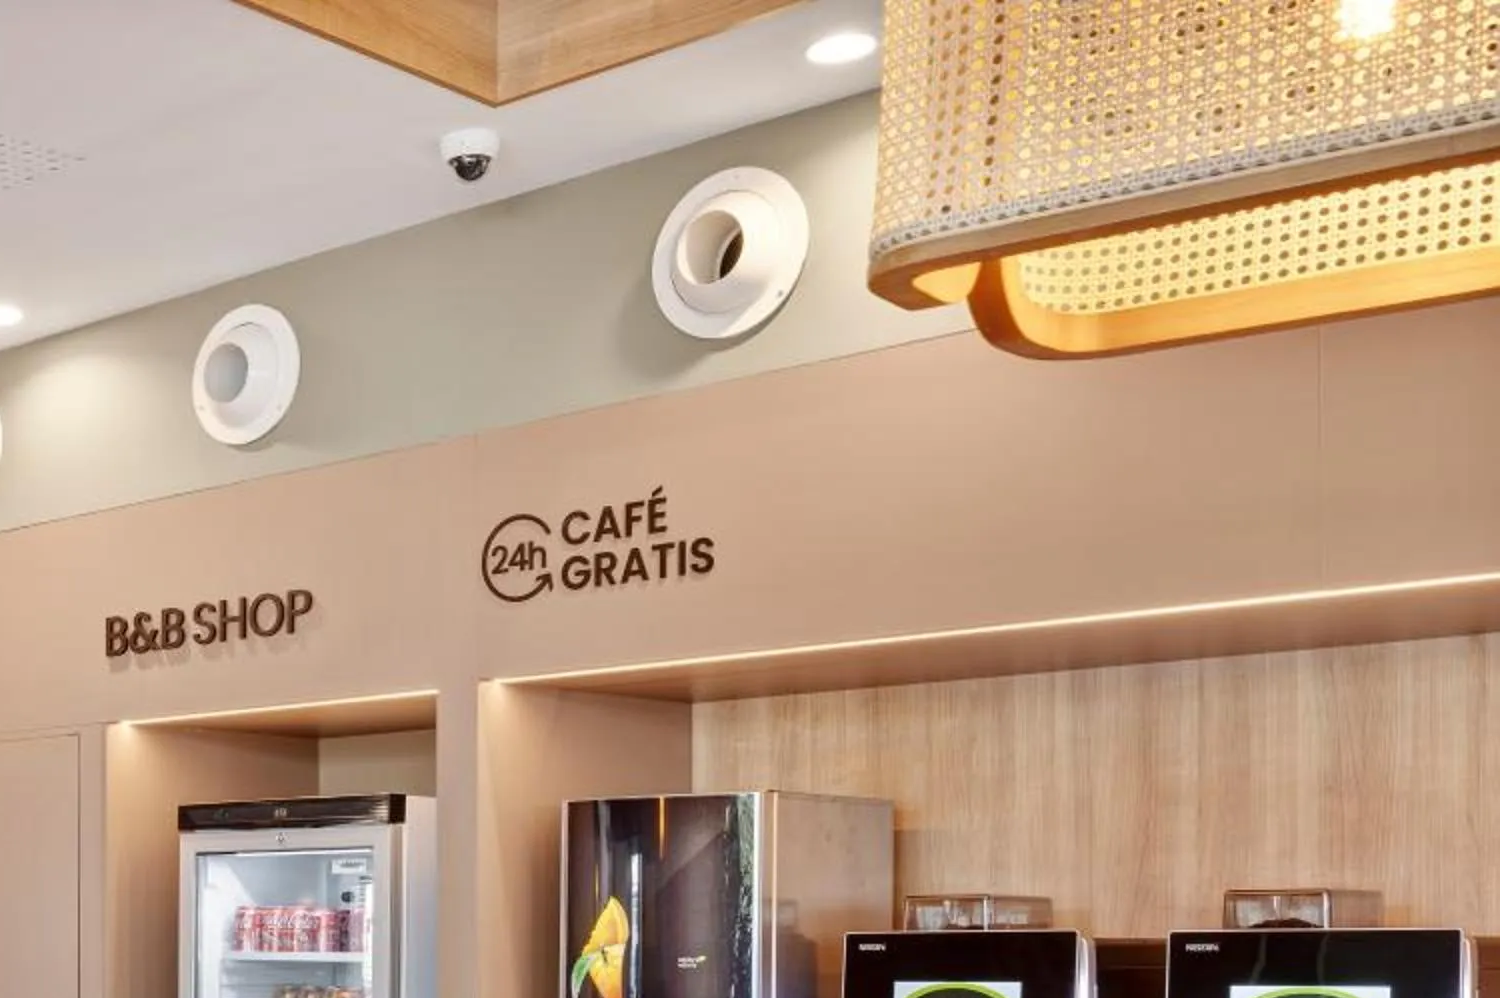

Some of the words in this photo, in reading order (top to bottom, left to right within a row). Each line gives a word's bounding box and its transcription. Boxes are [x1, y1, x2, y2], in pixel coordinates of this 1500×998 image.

[491, 541, 547, 575] 24h
[561, 485, 668, 546] CAFÉ
[561, 537, 715, 590] GRATIS
[105, 607, 186, 657] B&B
[193, 589, 313, 645] SHOP
